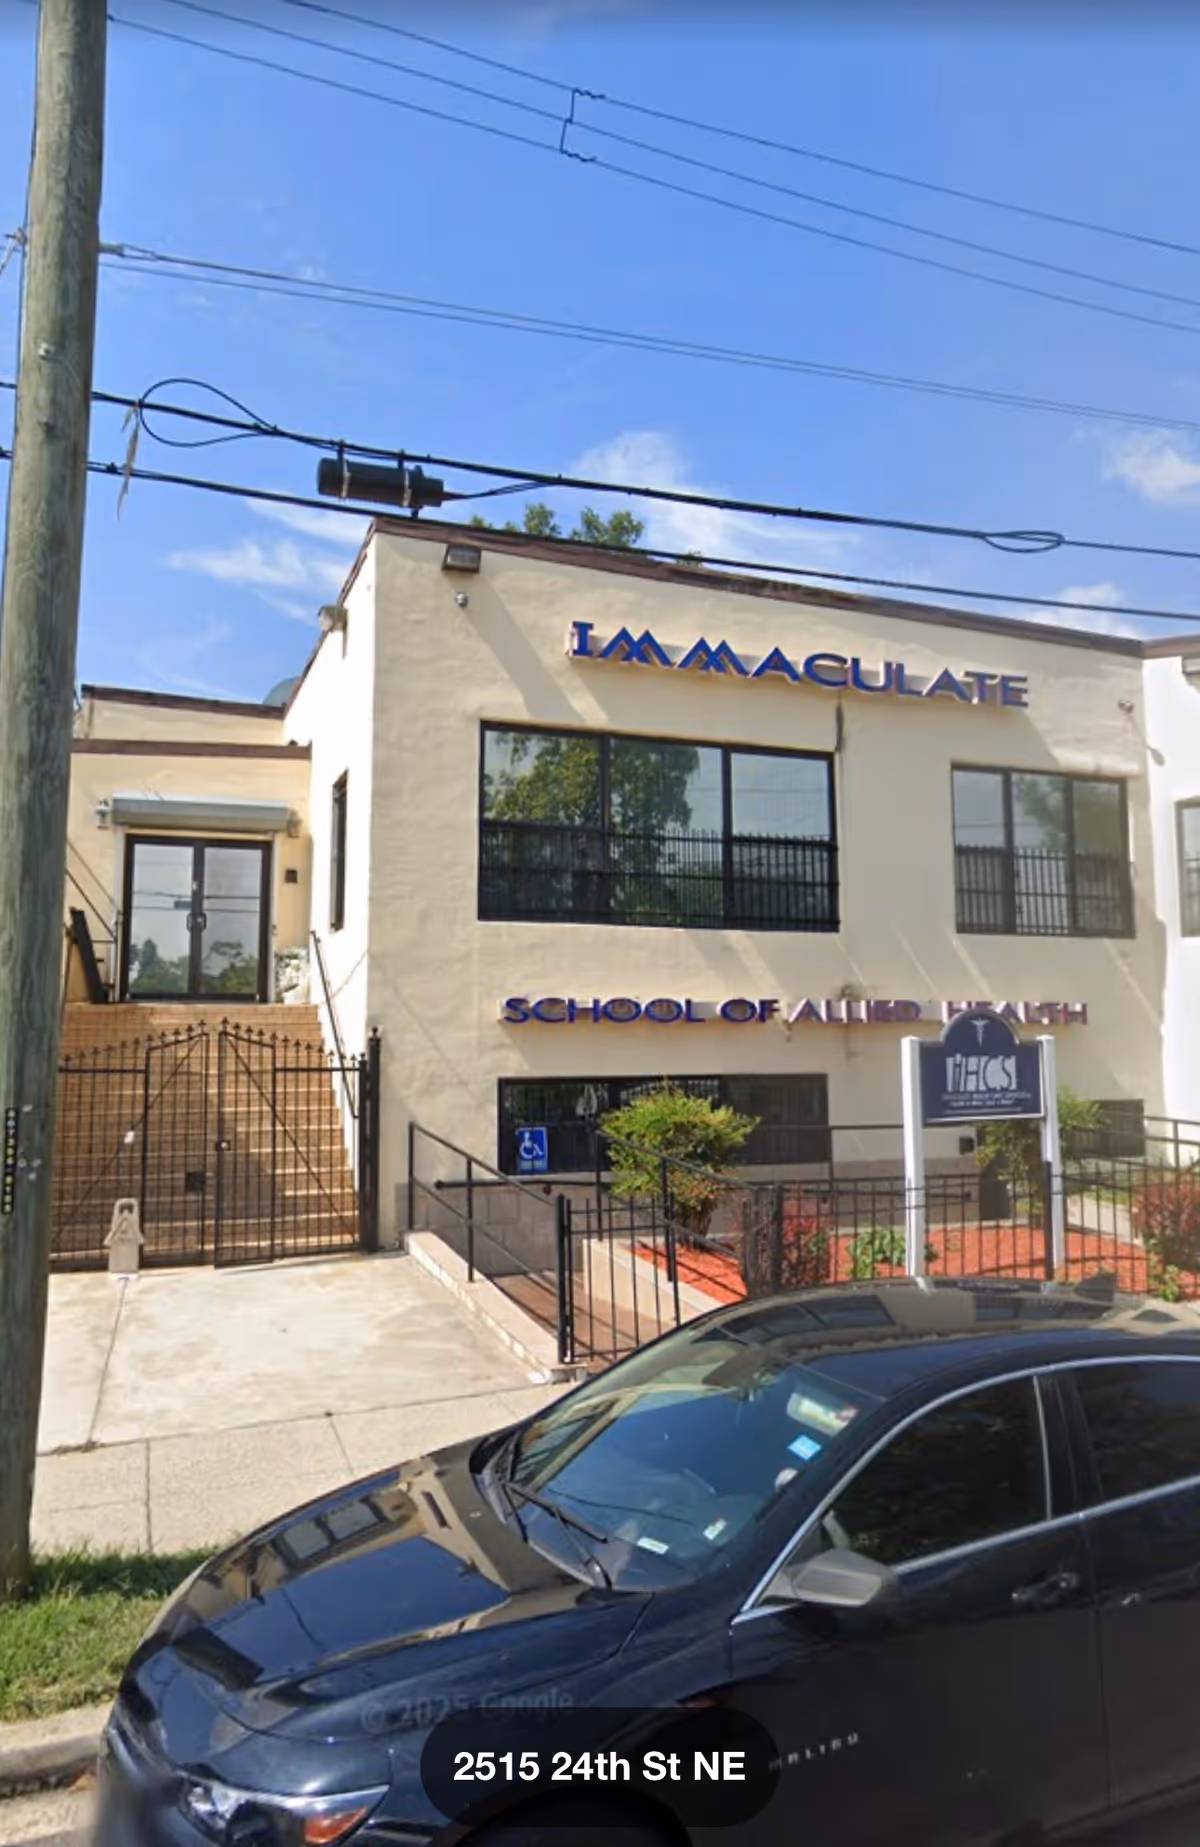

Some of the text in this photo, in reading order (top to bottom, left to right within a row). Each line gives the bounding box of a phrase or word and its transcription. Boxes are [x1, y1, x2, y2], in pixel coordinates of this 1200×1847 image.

[569, 621, 1029, 707] IMMACULATE
[503, 997, 705, 1024] SCHOOL
[719, 997, 780, 1024] OF
[788, 998, 922, 1024] ALLIED
